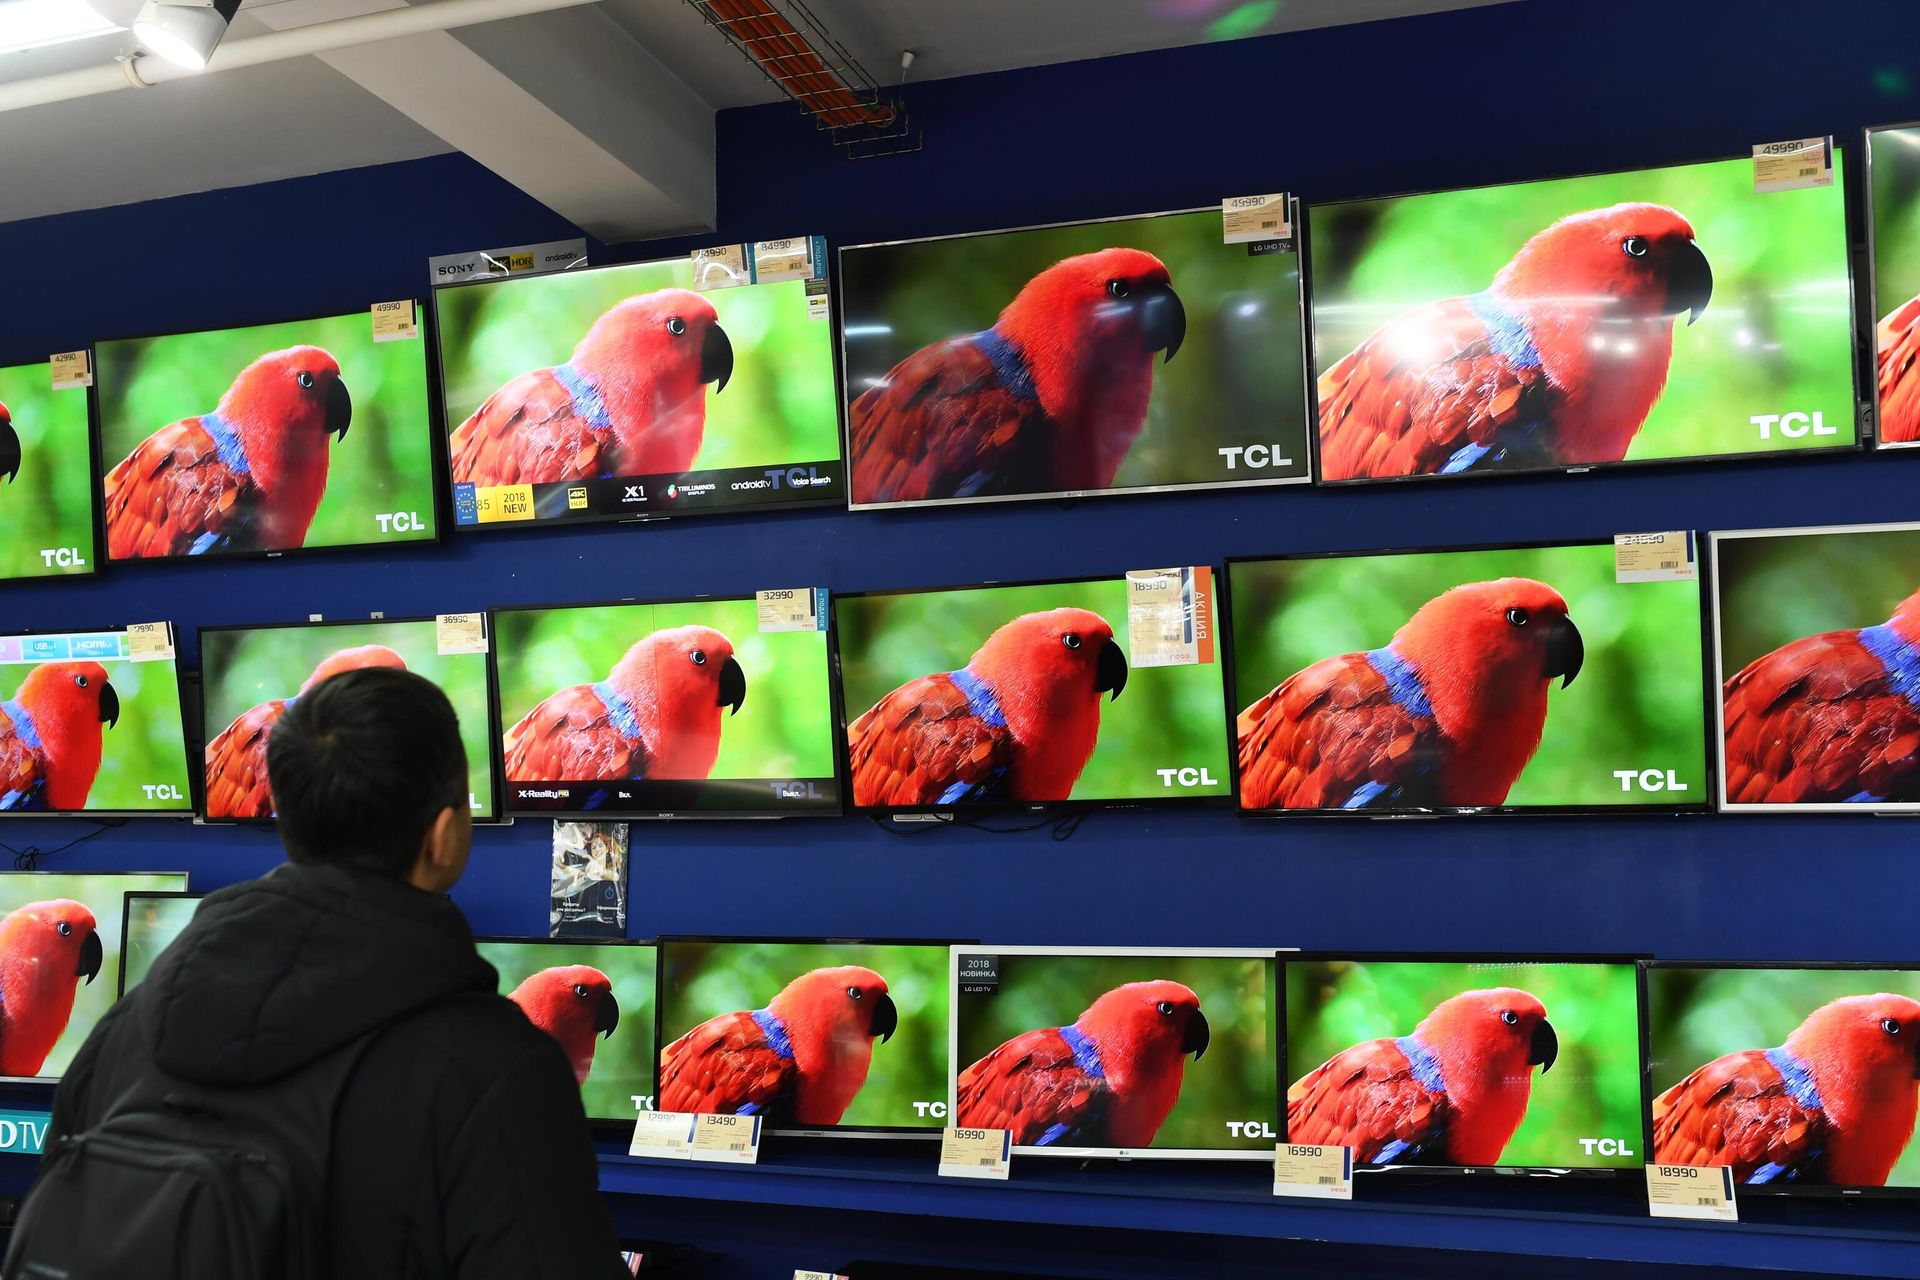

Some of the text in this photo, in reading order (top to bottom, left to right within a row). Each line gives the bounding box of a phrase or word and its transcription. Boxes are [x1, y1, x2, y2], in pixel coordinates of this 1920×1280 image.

[1763, 141, 1804, 155] 49990
[1231, 196, 1266, 208] 49990
[698, 247, 727, 258] 4990
[438, 263, 475, 276] SONY
[511, 256, 533, 267] HDR
[376, 302, 401, 311] 49990
[55, 353, 77, 362] 42990
[1750, 411, 1837, 440] TCL
[1218, 444, 1292, 469] TCL
[765, 467, 827, 490] TCL
[792, 476, 831, 486] Voice Search
[503, 492, 526, 503] 2018
[569, 489, 585, 498] 4K
[503, 503, 527, 514] NEW
[570, 499, 587, 508] HDR
[375, 511, 425, 533] TCL
[40, 548, 85, 568] TCL
[1134, 580, 1167, 591] 18990
[763, 590, 794, 600] 32990
[1195, 591, 1207, 639] АКЦИЯ
[1156, 768, 1218, 787] TCL
[1613, 769, 1688, 792] TCL
[142, 784, 183, 800] TCL
[518, 789, 558, 799] X-Reality
[769, 781, 823, 800] TCL
[967, 959, 990, 968] 2018
[707, 1115, 737, 1126] 13490
[954, 1129, 985, 1140] 16990
[1226, 1121, 1276, 1138] TCL
[1288, 1145, 1322, 1157] 16990
[1579, 1138, 1633, 1156] TCL
[1659, 1166, 1698, 1178] 18990
